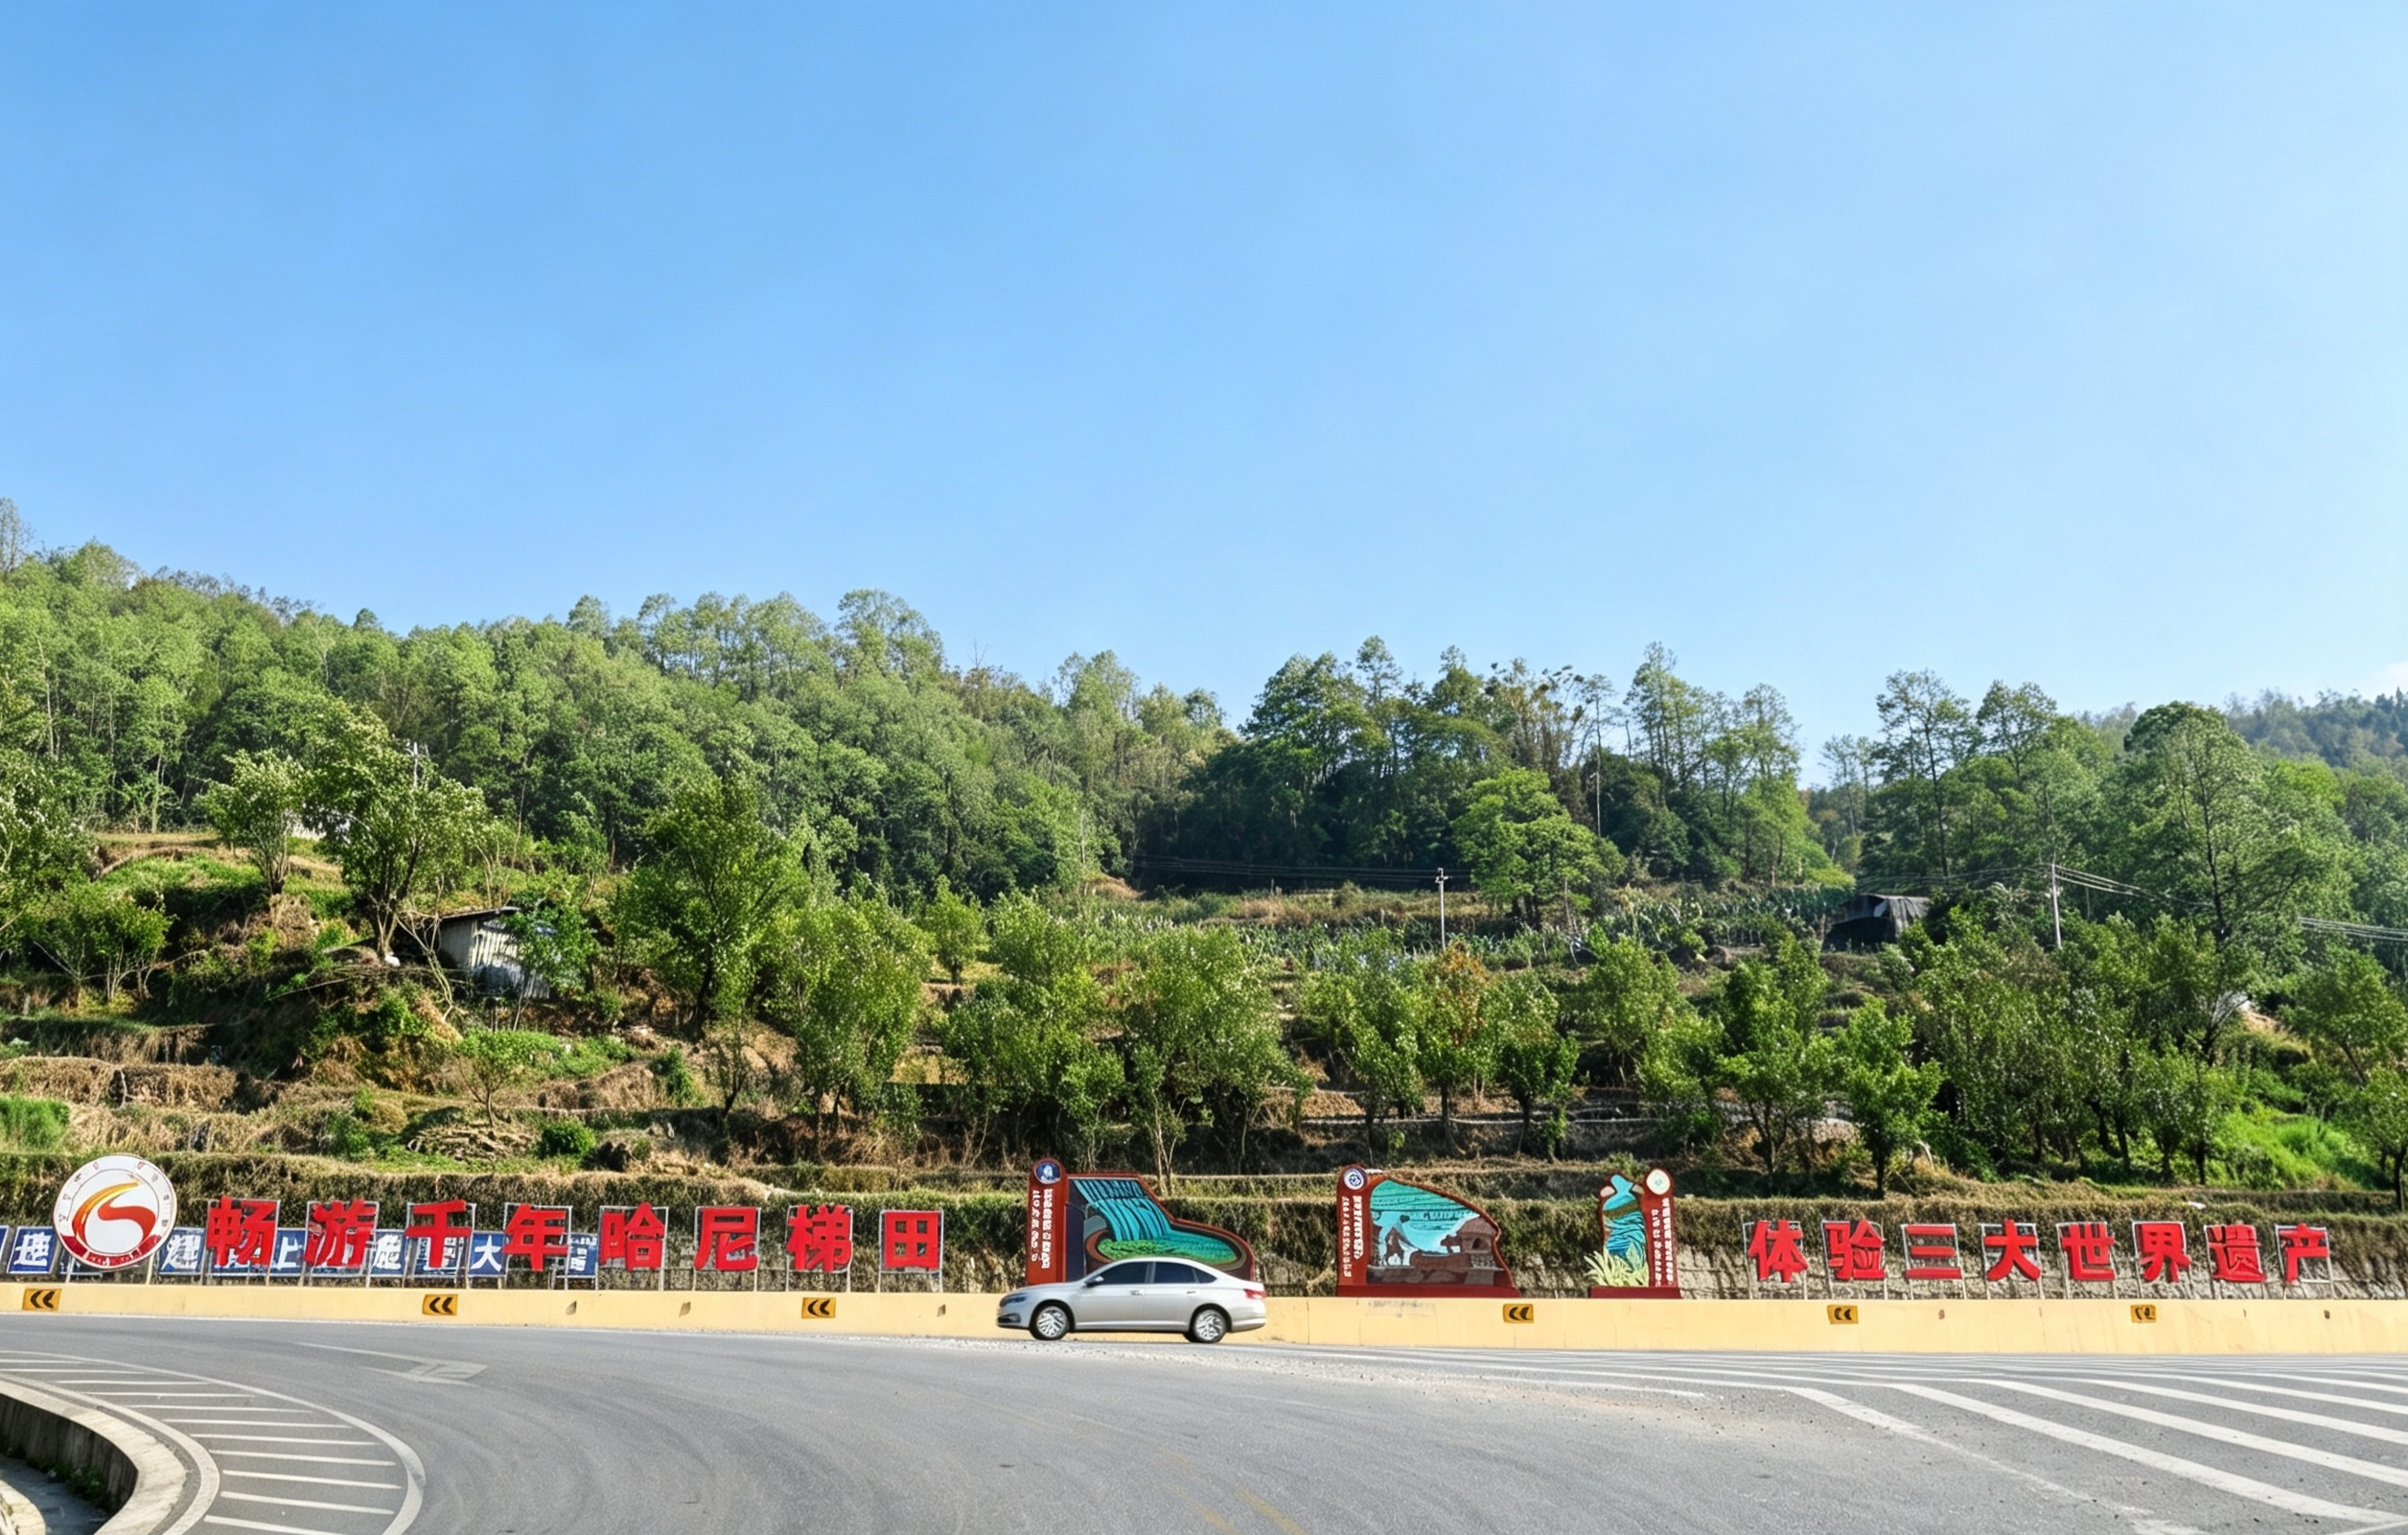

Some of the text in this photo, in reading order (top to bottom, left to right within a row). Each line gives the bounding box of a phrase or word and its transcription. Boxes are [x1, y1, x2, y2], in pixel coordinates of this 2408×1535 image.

[206, 1196, 942, 1272] 畅游千年哈尼梯田
[1748, 1219, 2330, 1283] 体验三大世界遗产
